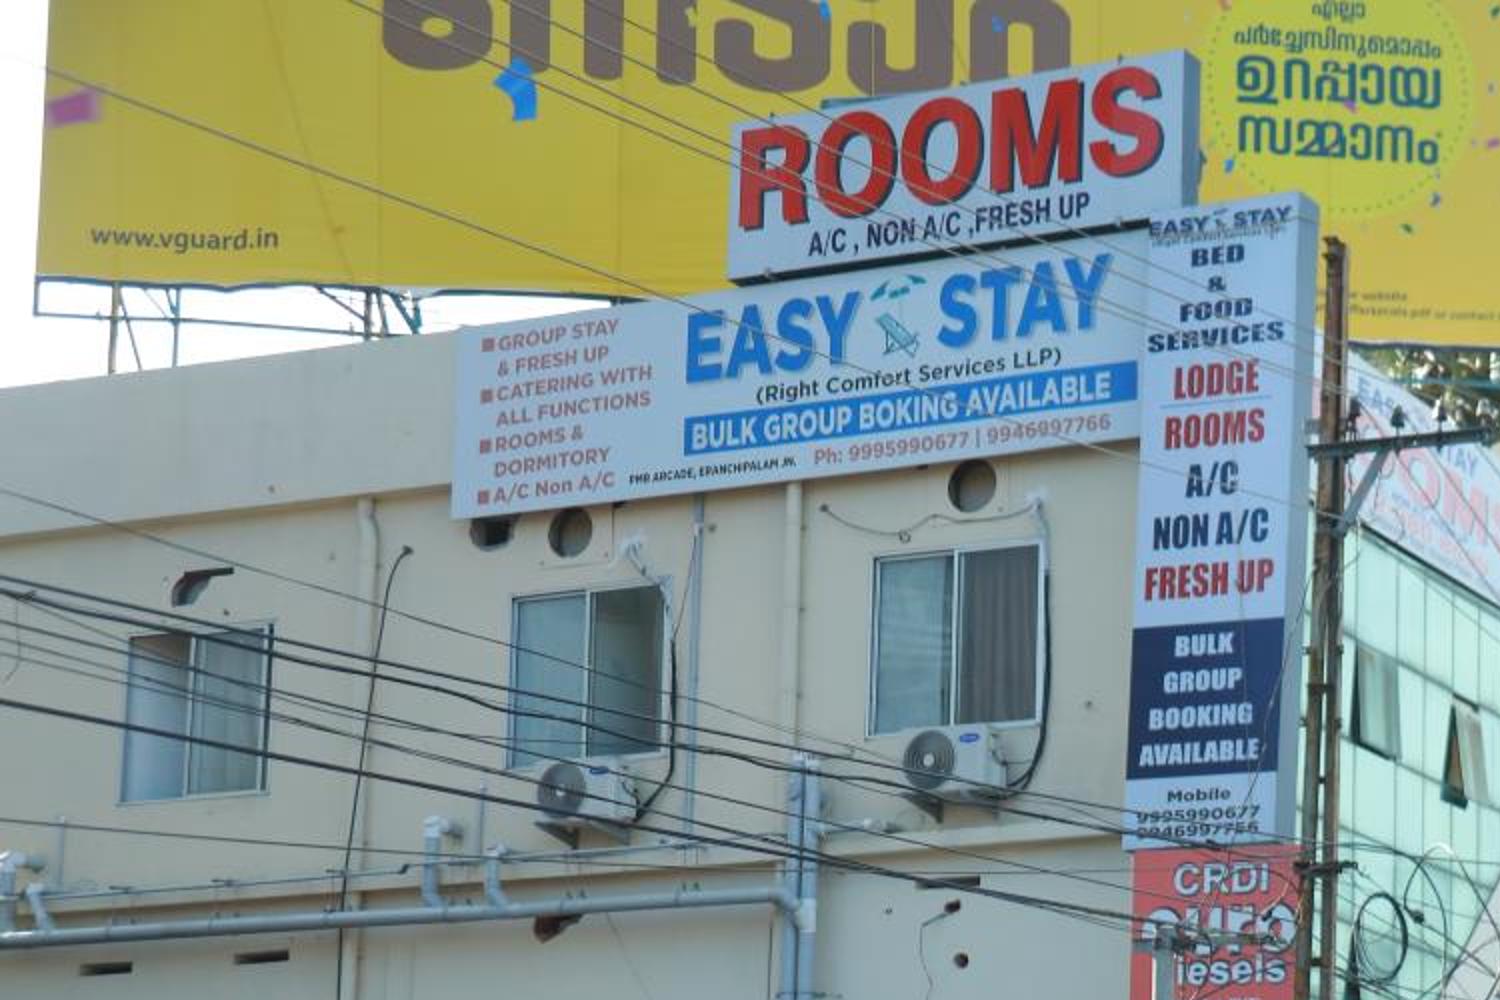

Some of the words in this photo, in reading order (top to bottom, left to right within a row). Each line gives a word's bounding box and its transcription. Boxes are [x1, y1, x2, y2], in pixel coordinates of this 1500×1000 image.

[1236, 55, 1441, 108] ഉറപ്പായ
[739, 66, 1164, 231] ROOMS
[1238, 115, 1439, 165] സമ്മാനം
[808, 229, 847, 257] A/C
[867, 221, 917, 249] NON
[923, 214, 962, 244] A/C
[1059, 192, 1092, 220] UP
[1150, 216, 1210, 237] EASY
[1234, 205, 1293, 227] STAY
[90, 227, 280, 255] www.vguard.in
[1190, 245, 1245, 267] BED
[1207, 275, 1227, 292] &
[685, 291, 862, 385] EASY
[936, 253, 1114, 349] STAY
[1179, 298, 1253, 323] FOOD
[498, 327, 567, 352] GROUP
[572, 319, 620, 339] STAY
[1148, 321, 1285, 353] SERVICES
[497, 360, 509, 377] &
[515, 351, 577, 374] FRESH
[583, 346, 609, 364] UP
[756, 380, 820, 406] (Right
[826, 369, 912, 396] Comfort
[919, 356, 1007, 384] Services
[1012, 348, 1063, 371] LLP)
[496, 373, 594, 400] CATERING
[600, 365, 653, 388] WITH
[1173, 358, 1261, 400] LODGE
[496, 409, 532, 428] ALL
[538, 391, 652, 422] FUNCTIONS
[691, 420, 757, 451] BULK
[764, 410, 853, 441] GROUP
[859, 396, 960, 432] BOKING
[964, 370, 1112, 417] AVAILABLE
[495, 430, 566, 453] ROOMS
[571, 425, 584, 441] &
[1164, 408, 1266, 450] ROOMS
[494, 448, 611, 478] DORMITORY
[814, 447, 843, 465] Ph:
[493, 481, 530, 502] A/C
[535, 476, 573, 496] Non
[579, 471, 616, 495] A/C
[1185, 460, 1240, 498] A/C
[1153, 512, 1209, 551] NON
[1215, 508, 1270, 546] A/C
[1145, 561, 1229, 602] FRESH
[1236, 558, 1275, 594] UP
[1174, 632, 1235, 658] BULK
[1163, 667, 1243, 694] GROUP
[1149, 702, 1254, 731] BOOKING
[1139, 738, 1261, 767] AVAILABLE
[1167, 788, 1232, 803] Mobile
[1173, 860, 1270, 896] CRDI
[1177, 953, 1287, 986] iesels
